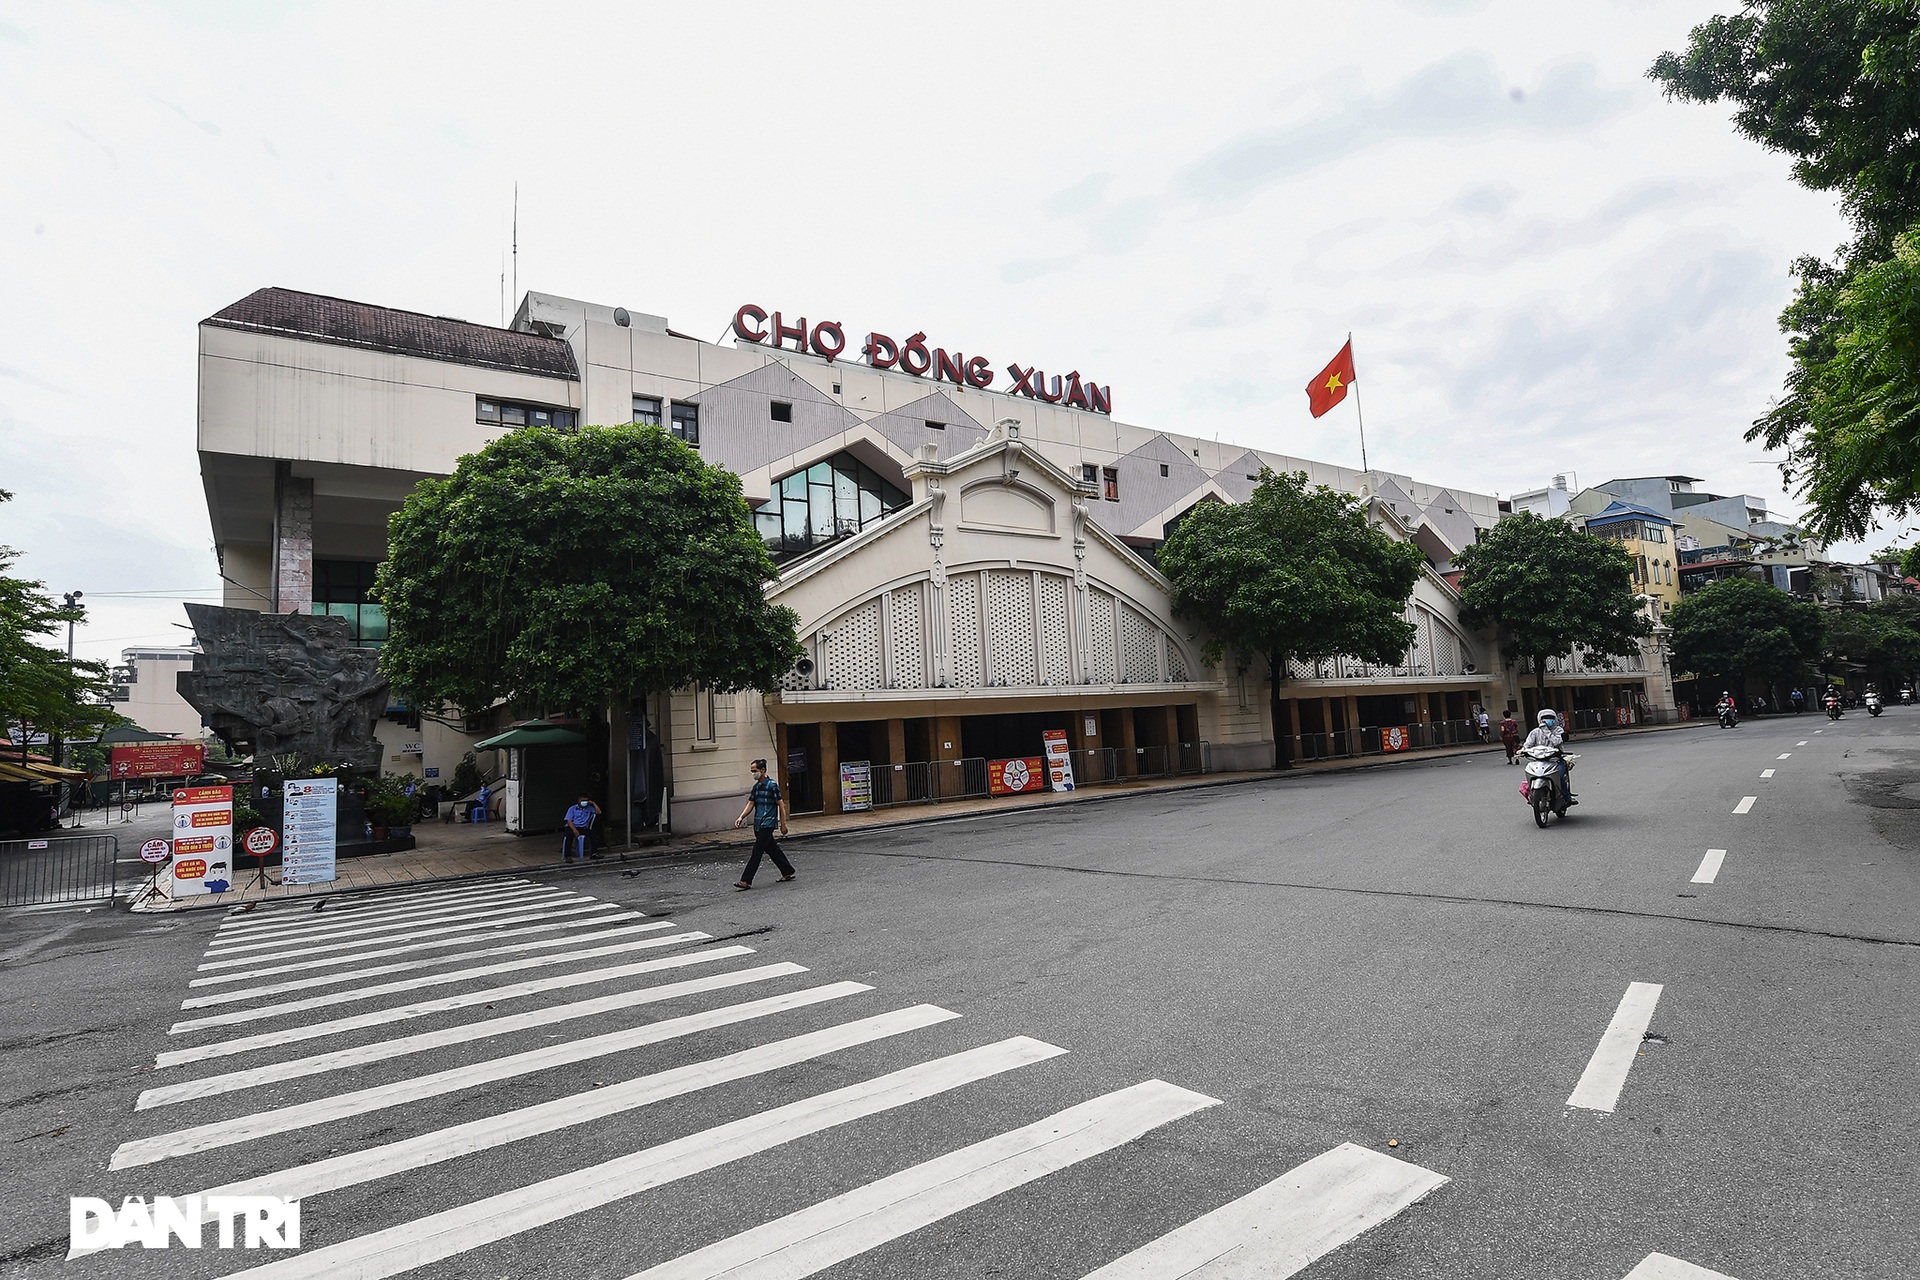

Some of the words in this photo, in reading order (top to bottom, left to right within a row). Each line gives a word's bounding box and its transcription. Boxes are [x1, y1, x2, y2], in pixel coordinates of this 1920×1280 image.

[732, 304, 846, 363] CHỢ
[861, 331, 994, 388] ĐỒNG
[1007, 363, 1112, 413] XUÂN
